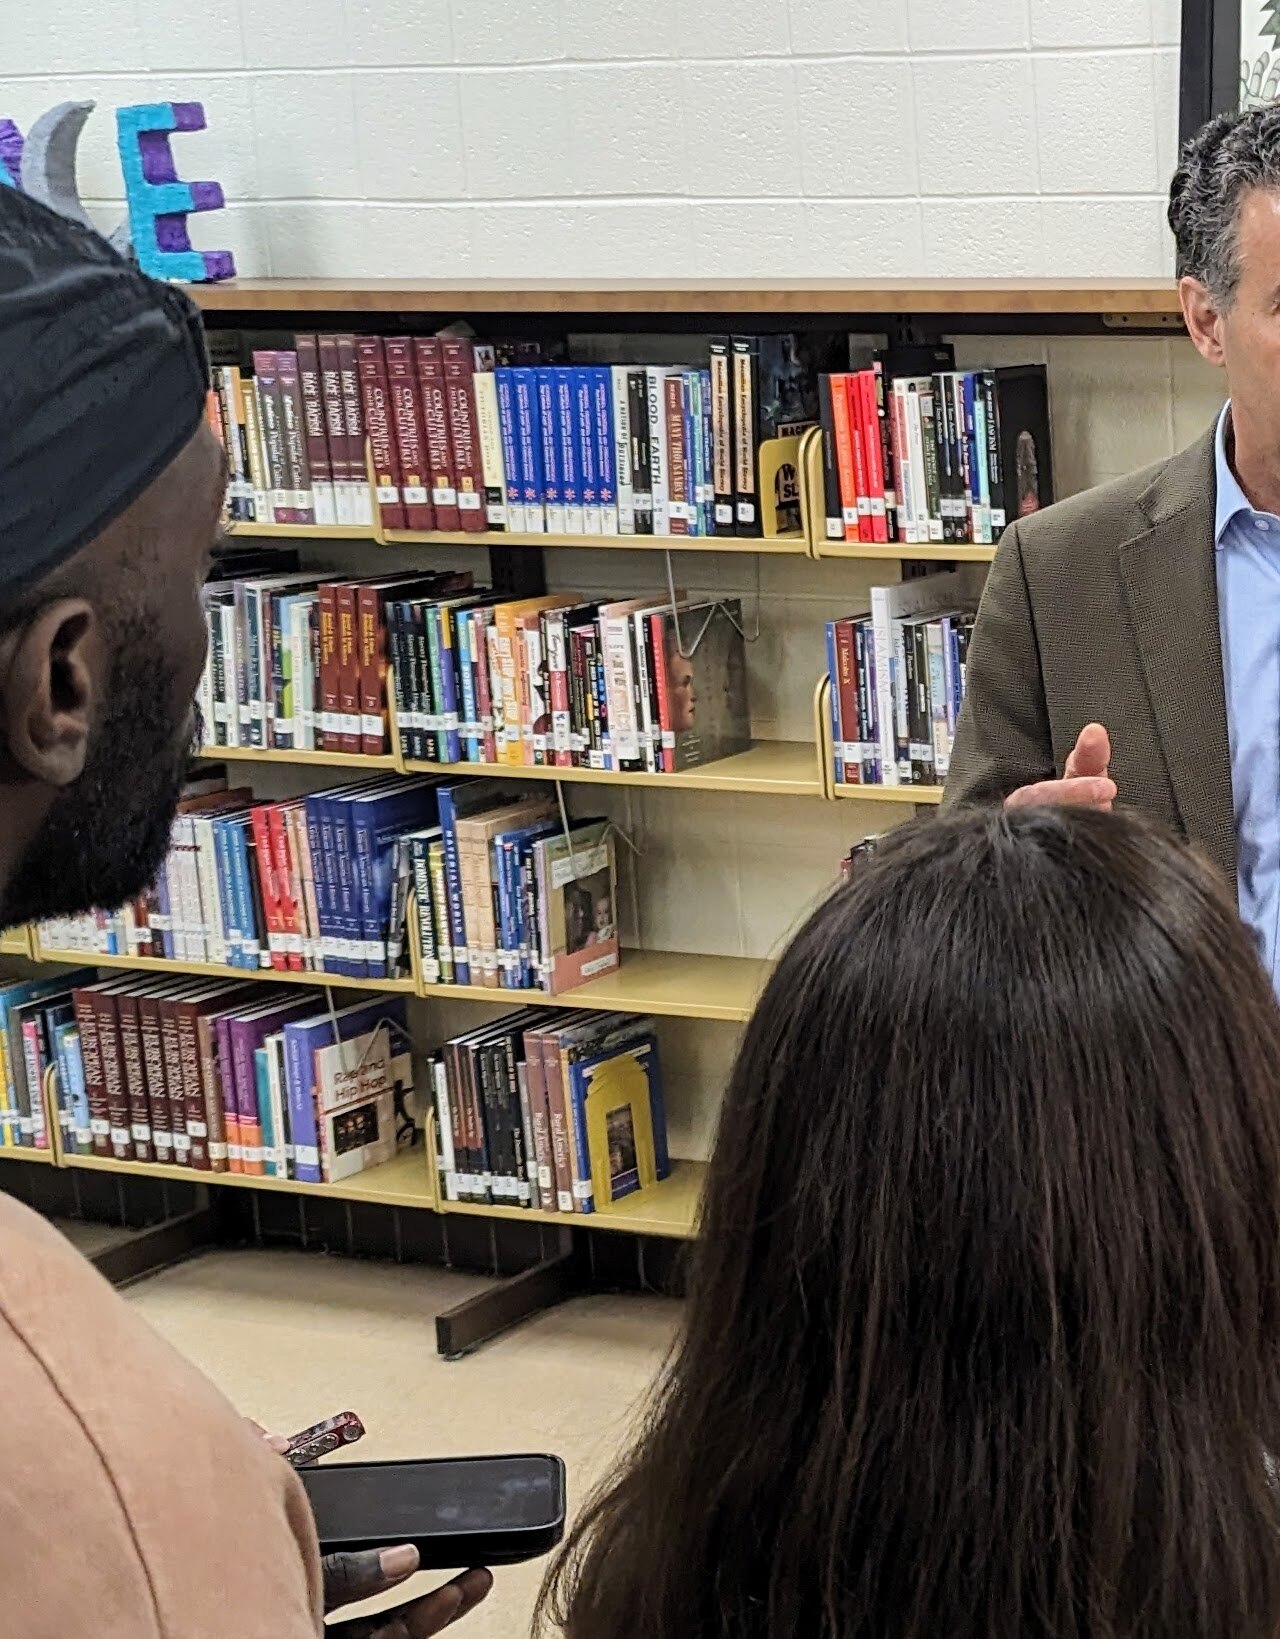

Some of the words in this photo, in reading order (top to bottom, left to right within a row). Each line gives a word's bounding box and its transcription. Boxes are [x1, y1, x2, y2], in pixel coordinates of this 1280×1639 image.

[303, 372, 315, 395] RACE
[324, 371, 336, 395] RACE
[342, 371, 354, 394] RACE
[648, 376, 659, 424] BLOOD
[306, 401, 319, 436] RACISM
[327, 400, 341, 436] RACISM
[345, 400, 359, 436] RACISM
[374, 388, 391, 449] COUNTRIES
[402, 389, 419, 450] COUNTRIES
[432, 389, 449, 451] COUNTRIES
[457, 389, 474, 451] COUNTRIES
[671, 414, 681, 439] MANY
[717, 396, 726, 438] Encyclopedia
[740, 394, 749, 436] Encyclopedia
[287, 431, 300, 463] Popular
[369, 407, 384, 469] CULTURES
[397, 408, 413, 469] CULTURES
[427, 409, 442, 470] CULTURES
[452, 409, 467, 470] CULTURES
[988, 419, 997, 450] FASCISM
[651, 437, 662, 485] EARTH
[672, 442, 684, 492] THOUSANDS
[742, 446, 750, 465] World
[841, 445, 849, 466] Latin
[719, 468, 727, 492] Slavery
[742, 467, 750, 490] Slavery
[843, 468, 852, 502] America
[418, 636, 426, 658] Slavery
[841, 648, 850, 677] Malcolm
[877, 625, 889, 694] ISLAMISM
[464, 667, 472, 691] BODY
[519, 670, 528, 706] Engineering
[465, 694, 474, 718] TALK
[414, 859, 429, 903] DOMESTIC
[445, 830, 458, 887] MATERIAL
[452, 893, 463, 933] WORLD
[419, 905, 435, 959] REVOLUTION
[87, 1022, 103, 1085] EUROPEAN
[106, 1032, 122, 1095] EUROPEAN
[535, 1112, 545, 1134] Rural
[554, 1113, 564, 1134] Rural
[556, 1136, 567, 1168] America
